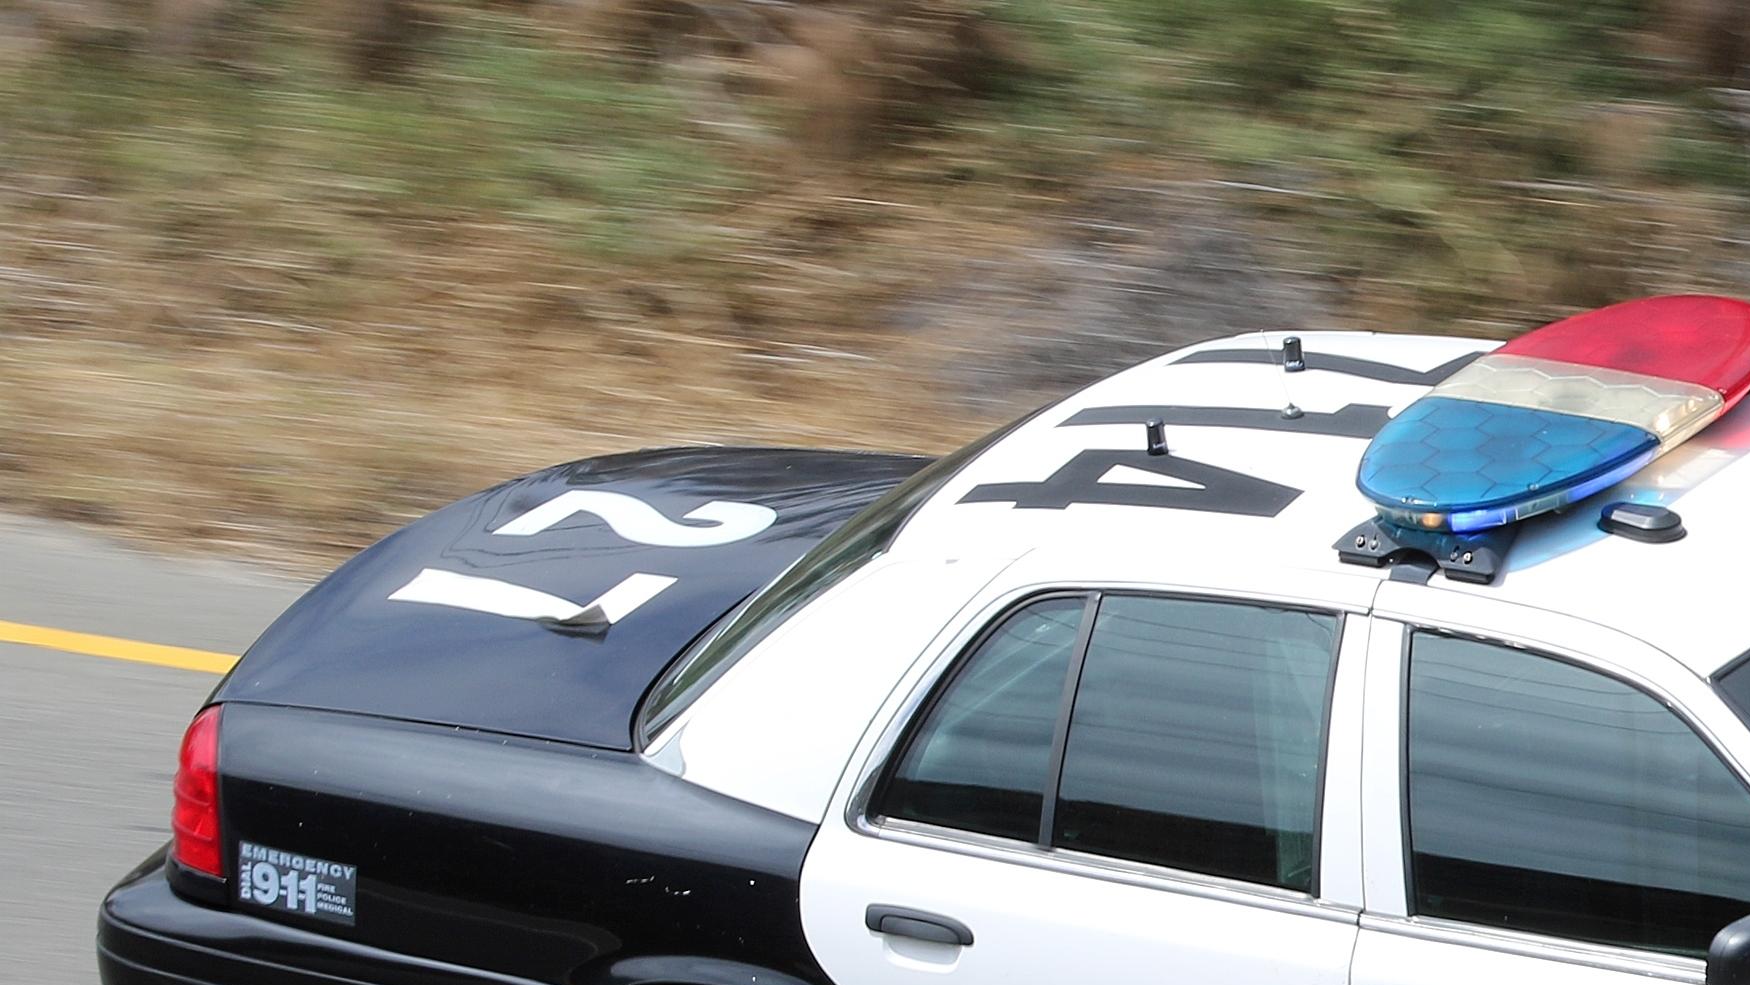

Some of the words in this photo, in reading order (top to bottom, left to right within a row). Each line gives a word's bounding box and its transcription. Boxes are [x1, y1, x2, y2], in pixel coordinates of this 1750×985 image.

[241, 843, 355, 880] EMERGENCY
[241, 861, 251, 900] DIAL
[317, 883, 336, 893] FIRE
[317, 893, 347, 904] POLICE
[317, 903, 353, 915] MEDICAL
